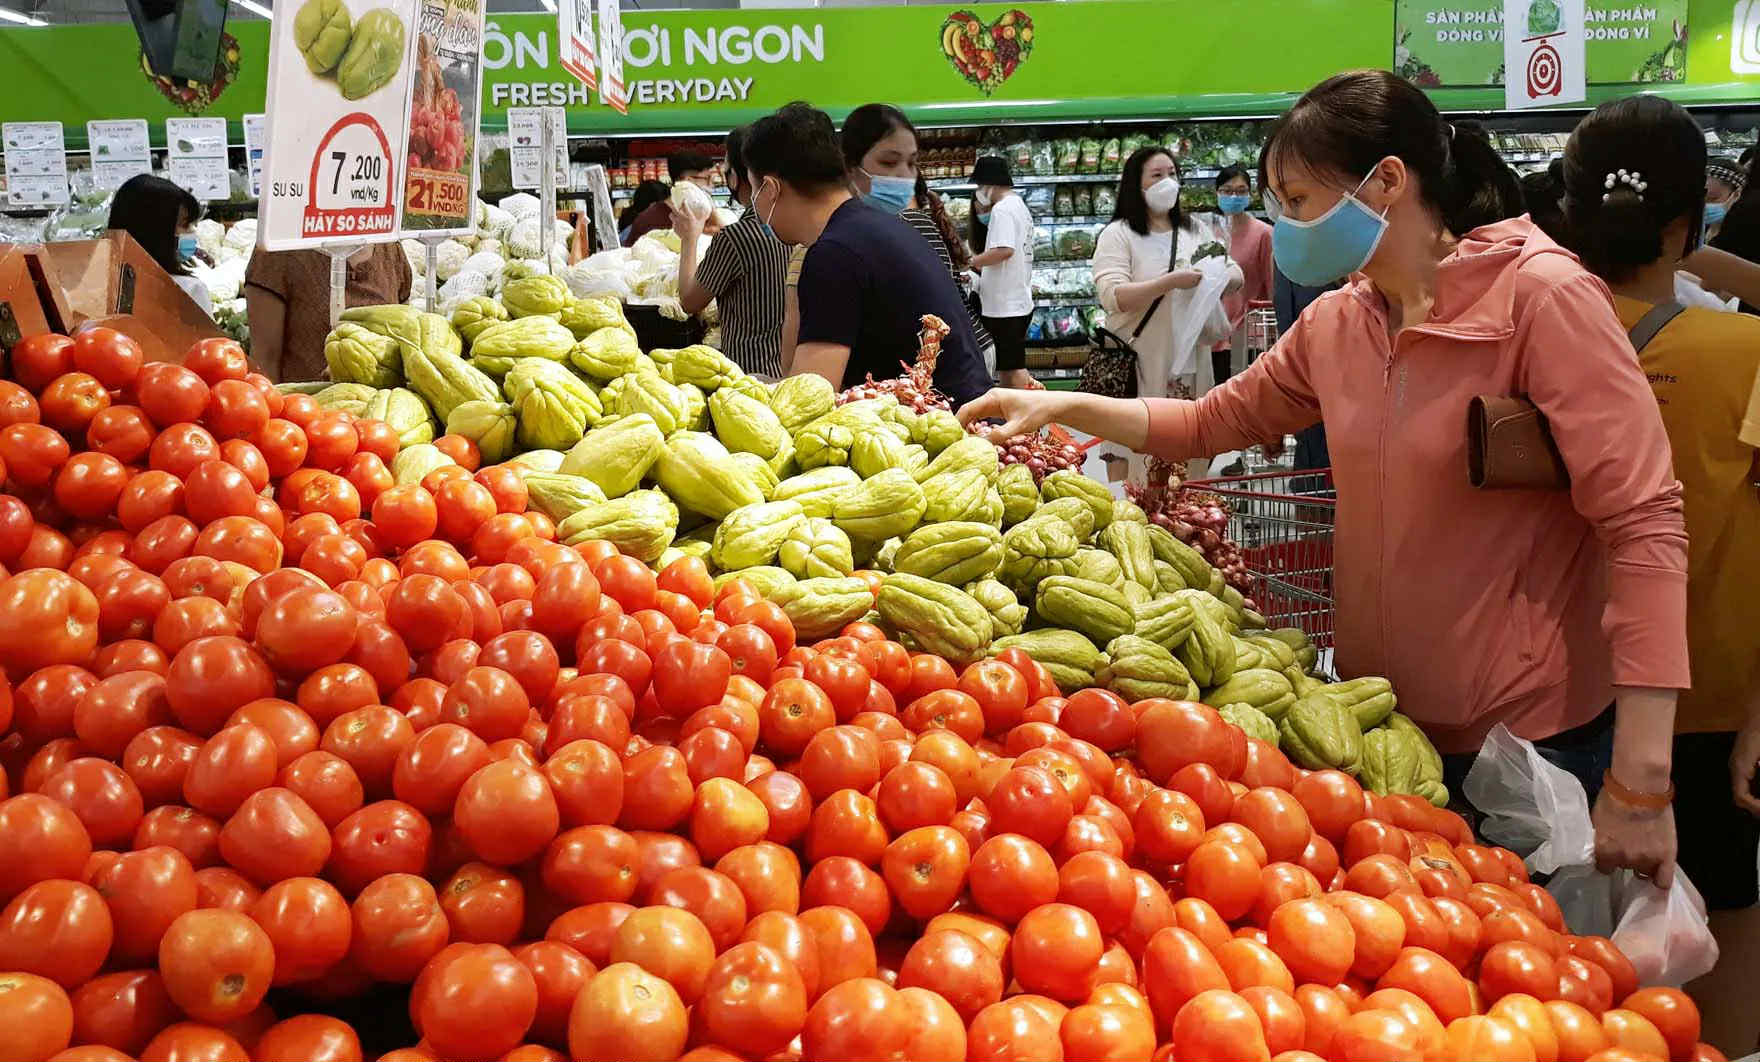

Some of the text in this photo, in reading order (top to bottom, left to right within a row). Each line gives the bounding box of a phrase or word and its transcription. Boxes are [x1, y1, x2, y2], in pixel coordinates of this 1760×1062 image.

[684, 24, 824, 65] NGON
[492, 82, 588, 106] FRESH
[273, 182, 303, 197] SU SU
[305, 211, 393, 233] HÃY SO SÁNH
